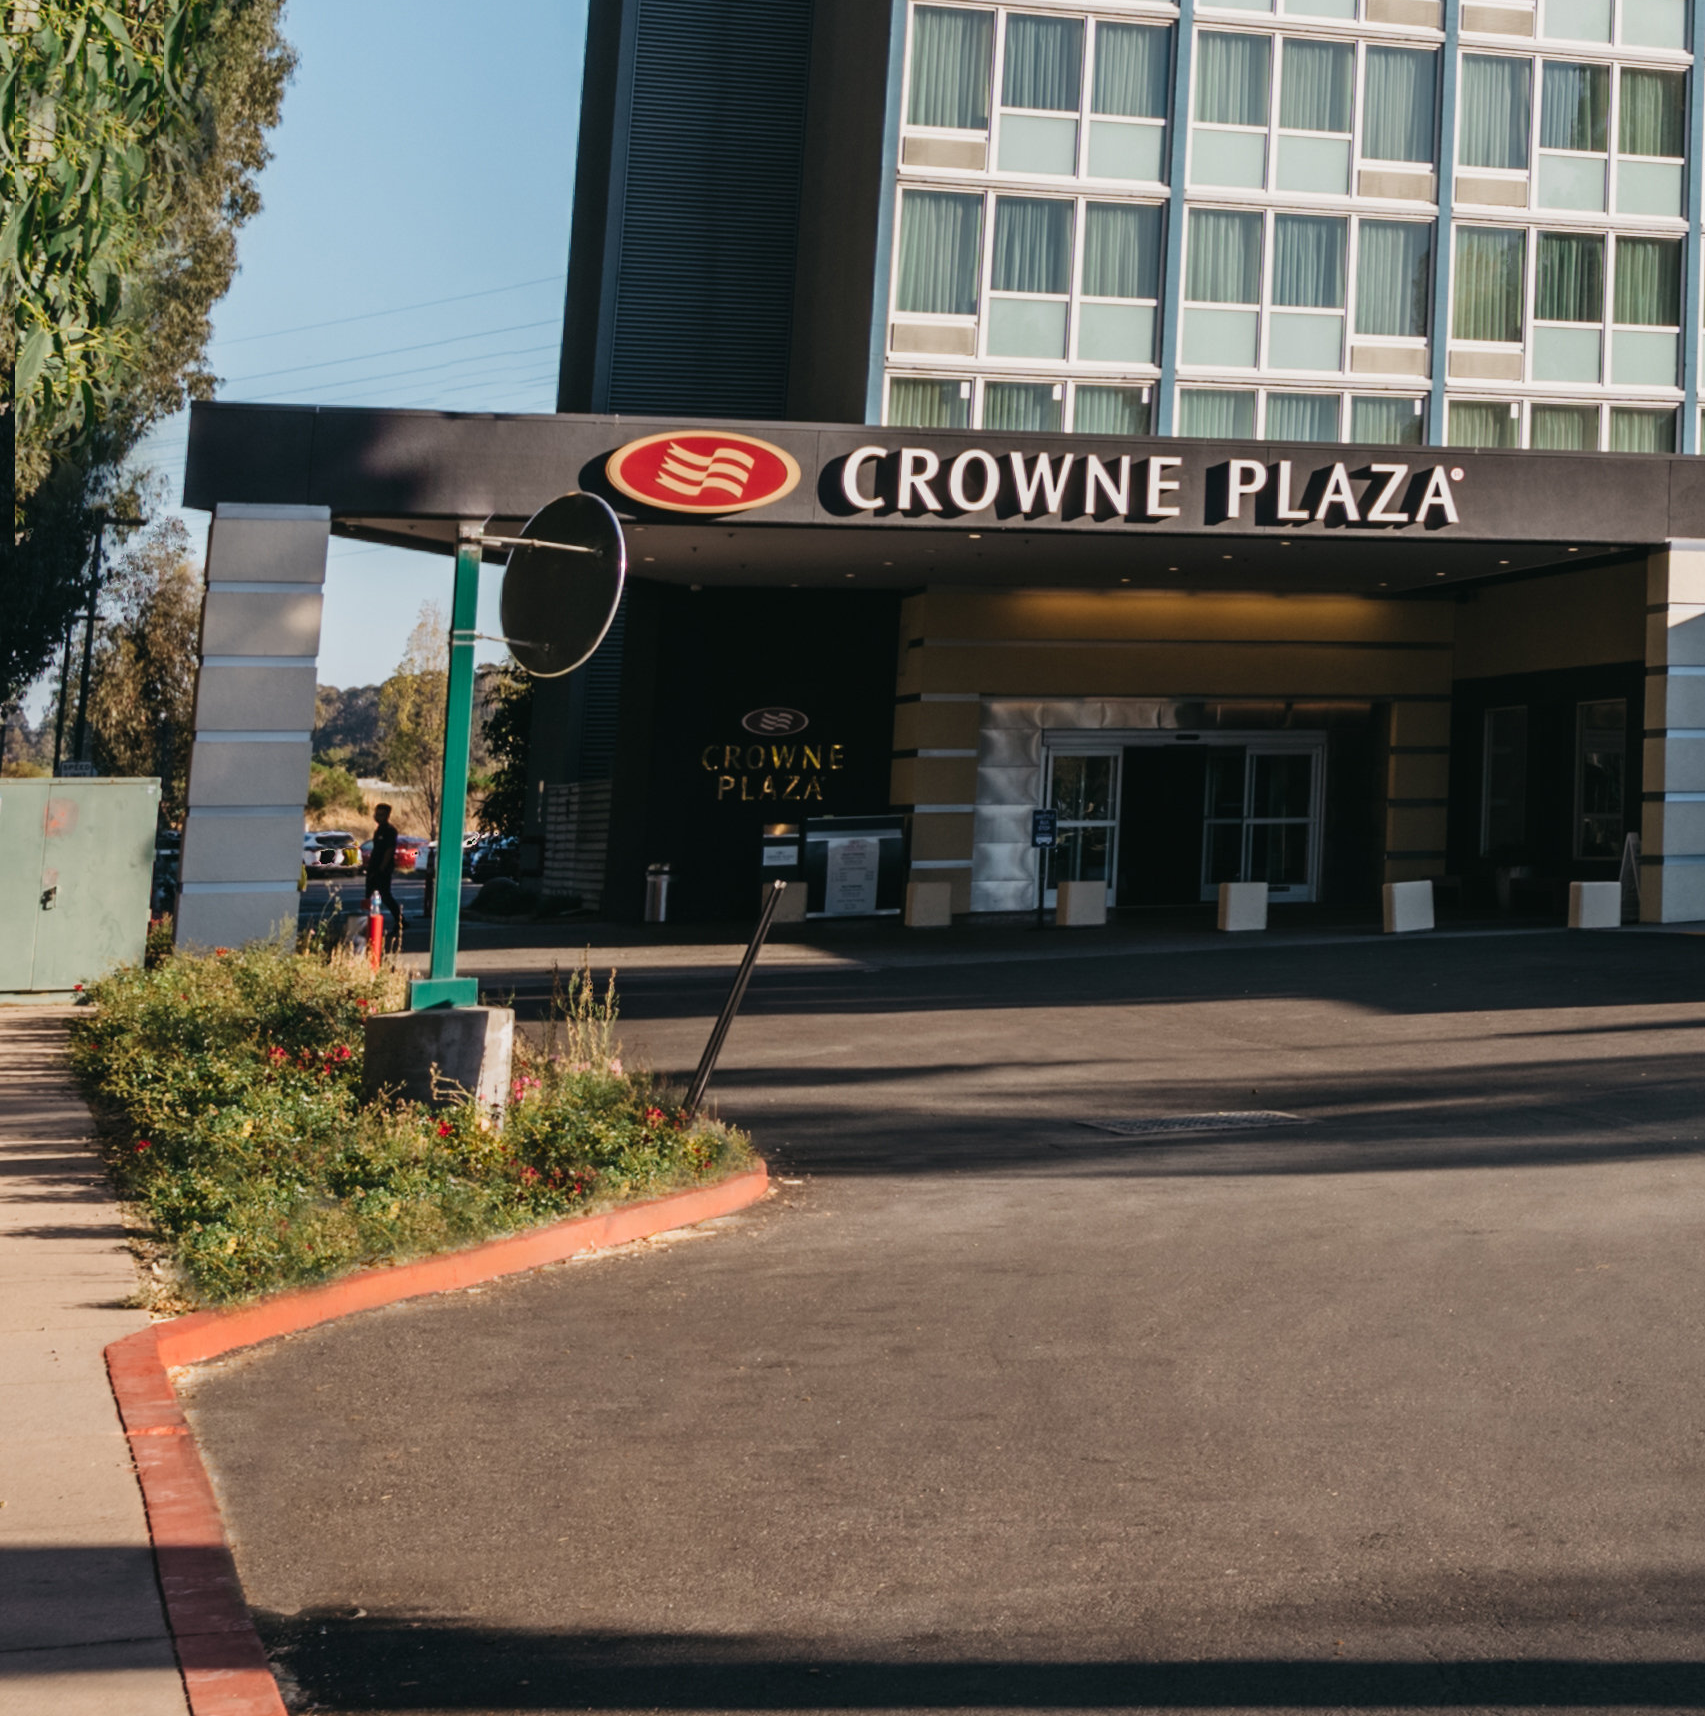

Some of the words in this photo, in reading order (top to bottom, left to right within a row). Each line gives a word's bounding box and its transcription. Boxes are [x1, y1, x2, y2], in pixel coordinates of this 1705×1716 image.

[842, 446, 1183, 517] CROWNE
[1227, 458, 1460, 524] PLAZA
[702, 744, 845, 771] CROWNE
[717, 774, 824, 801] PLAZA
